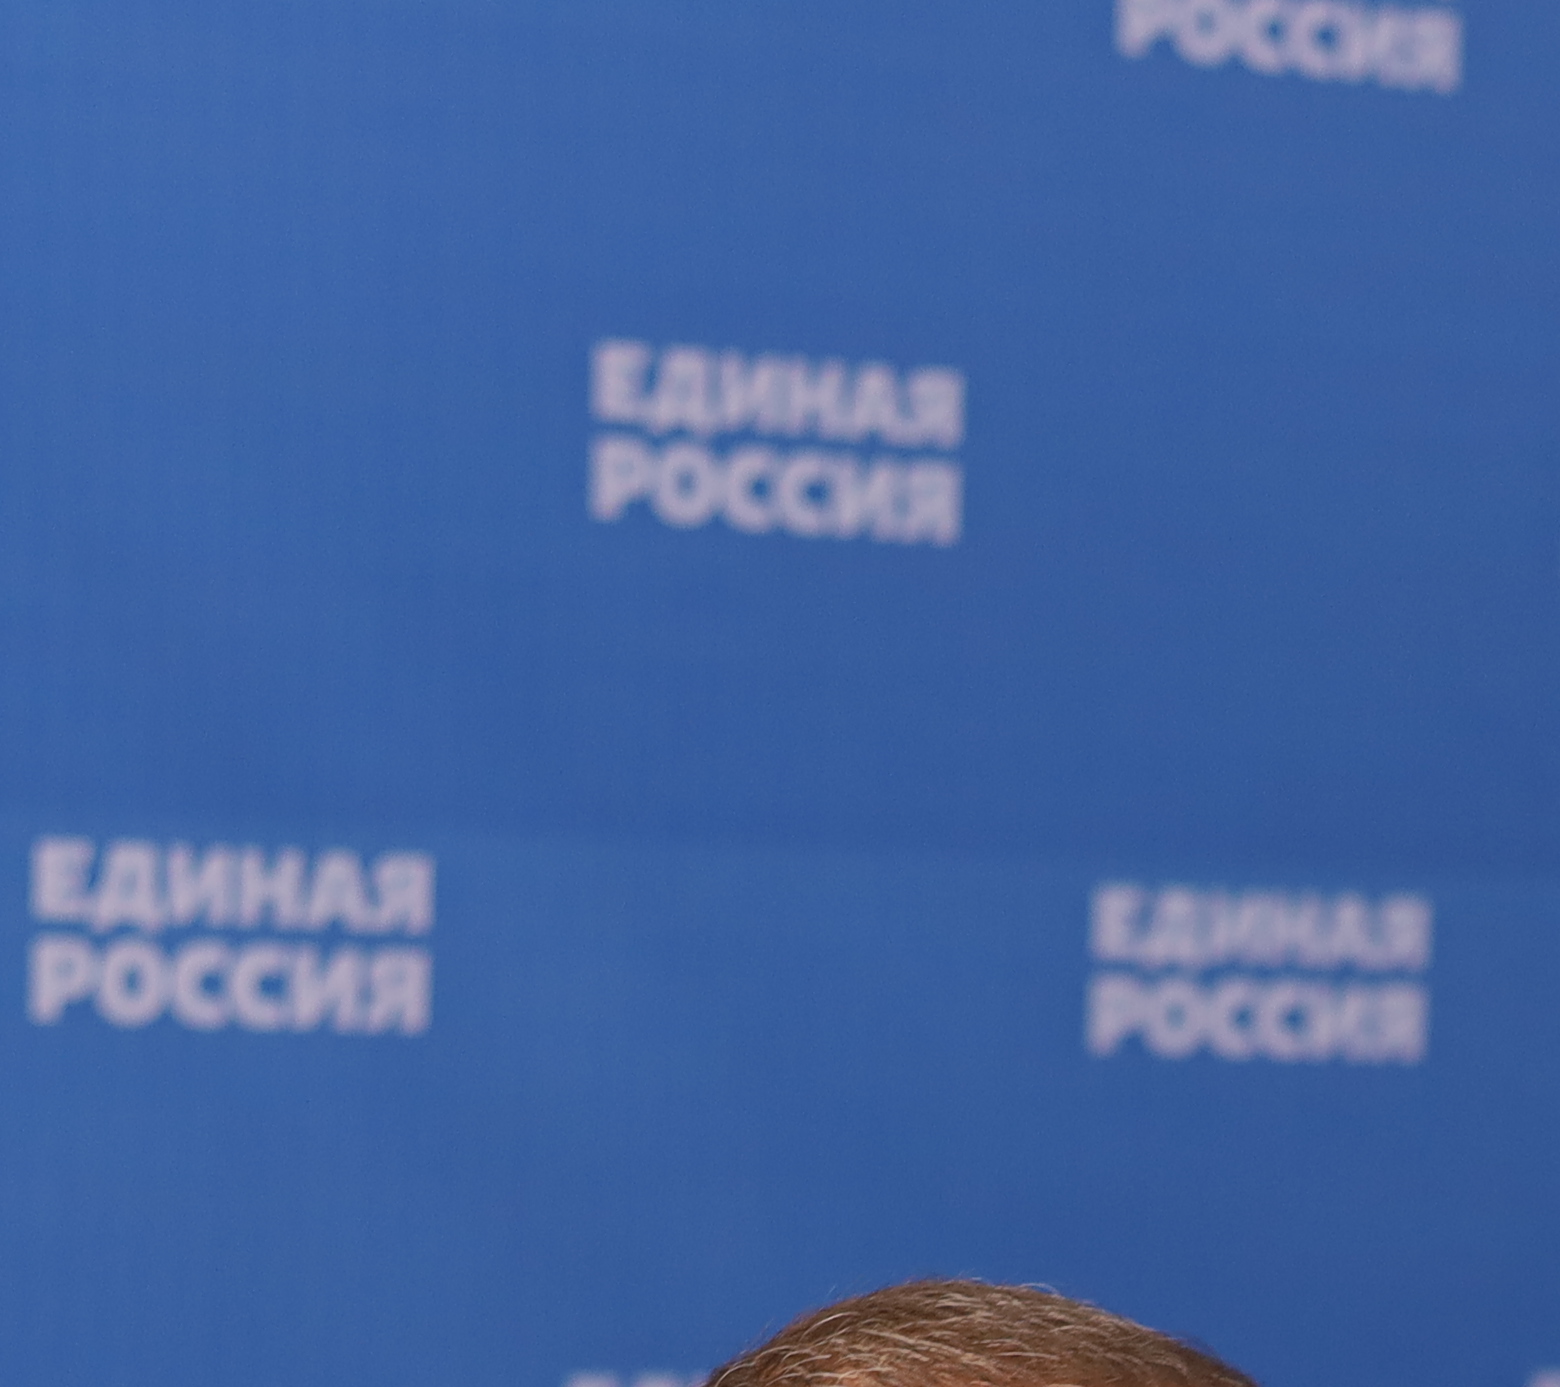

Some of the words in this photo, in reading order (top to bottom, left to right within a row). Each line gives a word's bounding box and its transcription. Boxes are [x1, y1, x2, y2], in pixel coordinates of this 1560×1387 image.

[593, 341, 962, 446] ЕДИНАЯ
[592, 435, 960, 543] РОССИЯ
[32, 838, 432, 933] ЕДИНАЯ
[1092, 885, 1430, 971] ЕДИНАЯ
[30, 936, 430, 1032] РОССИЯ
[1088, 970, 1426, 1060] РОССИЯ
